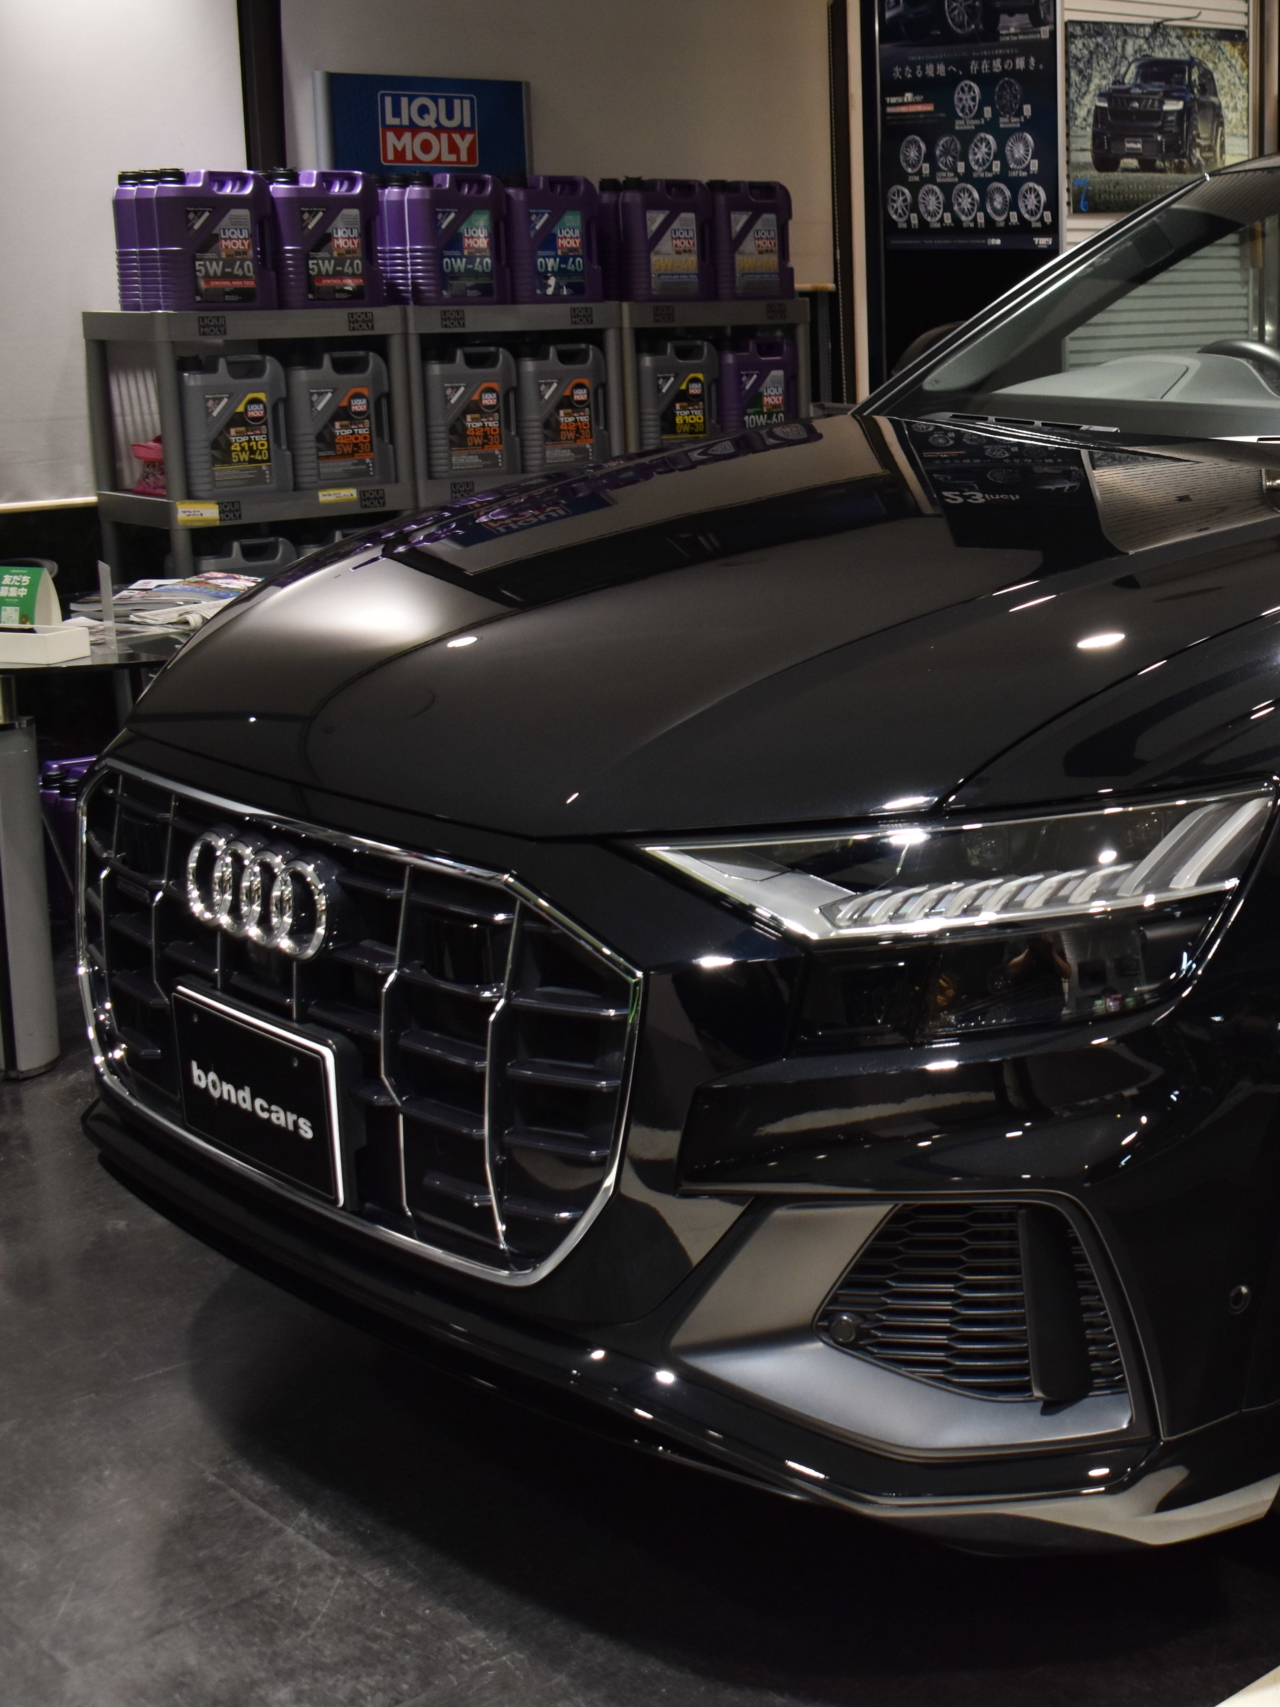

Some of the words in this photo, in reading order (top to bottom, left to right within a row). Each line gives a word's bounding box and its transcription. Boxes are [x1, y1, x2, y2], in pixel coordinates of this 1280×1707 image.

[384, 96, 472, 129] LIQUI
[386, 132, 475, 163] MOLY
[220, 228, 249, 238] LIQUI
[333, 228, 358, 238] LIQUI
[464, 228, 488, 237] LIQUI
[558, 228, 580, 237] LIQUI
[672, 229, 694, 238] LIQUI
[754, 230, 774, 238] LIQUI
[221, 239, 250, 249] MOLY
[334, 238, 360, 248] MOLY
[464, 238, 490, 247] MOLY
[558, 238, 581, 248] MOLY
[672, 239, 696, 248] MOLY
[755, 239, 776, 248] MOLY
[195, 260, 254, 277] 5W-40
[308, 260, 362, 276] 5W-40
[442, 258, 492, 273] 0W-40
[537, 258, 584, 272] 0W-40
[653, 258, 696, 271] 5W-40
[349, 312, 373, 322] LIQUI
[442, 310, 464, 319] LIQUI
[571, 308, 592, 316] LIQUI
[199, 316, 225, 326] LIQUI
[442, 319, 465, 328] MOLY
[572, 316, 593, 324] MOLY
[200, 326, 226, 336] MOLY
[350, 322, 374, 330] MOLY
[764, 387, 783, 396] LIQUI
[764, 396, 784, 404] MOLY
[676, 415, 704, 424] 6100
[560, 422, 590, 430] 4210
[466, 427, 500, 436] 4210
[560, 430, 590, 440] 0W-30
[335, 434, 370, 444] 4200
[467, 436, 500, 446] 0W-30
[231, 440, 268, 451] 4110
[336, 443, 370, 454] 5W-30
[232, 450, 268, 463] 5W-40
[452, 482, 474, 490] LIQUI
[361, 490, 384, 499] LIQUI
[362, 498, 386, 508] MOLY
[2, 574, 31, 586] 友だち
